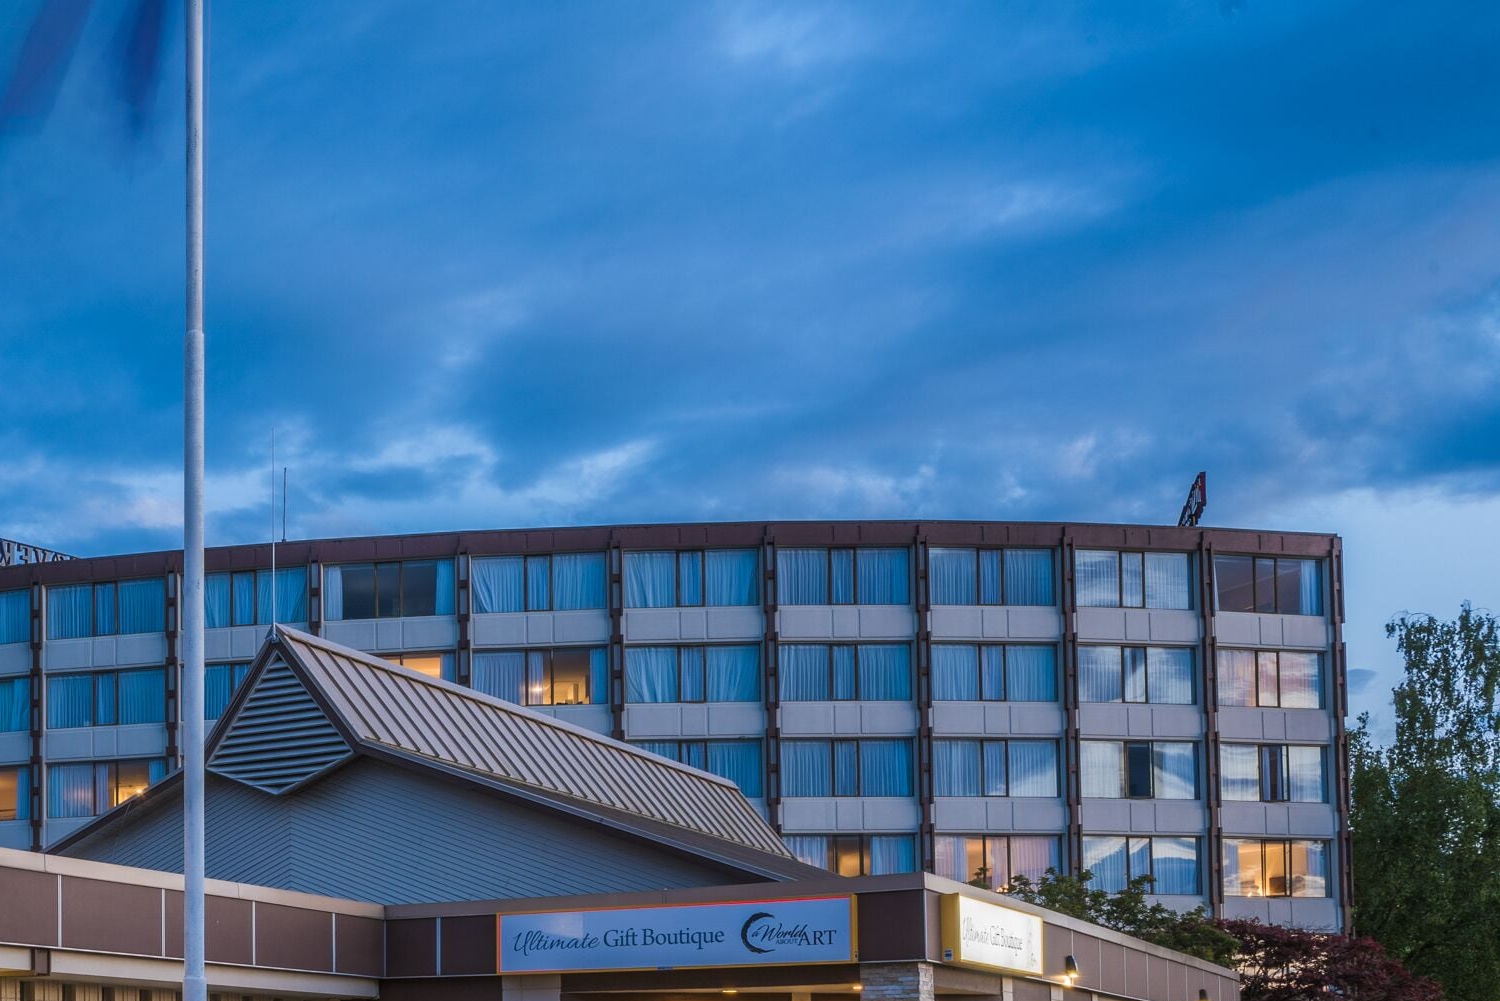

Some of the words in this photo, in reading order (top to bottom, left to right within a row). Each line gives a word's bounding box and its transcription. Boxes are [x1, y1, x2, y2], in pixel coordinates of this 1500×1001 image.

[513, 929, 600, 957] Ultimate
[603, 926, 638, 948] Gift
[642, 926, 725, 951] Boutique
[758, 923, 808, 942] World
[797, 930, 837, 946] ART
